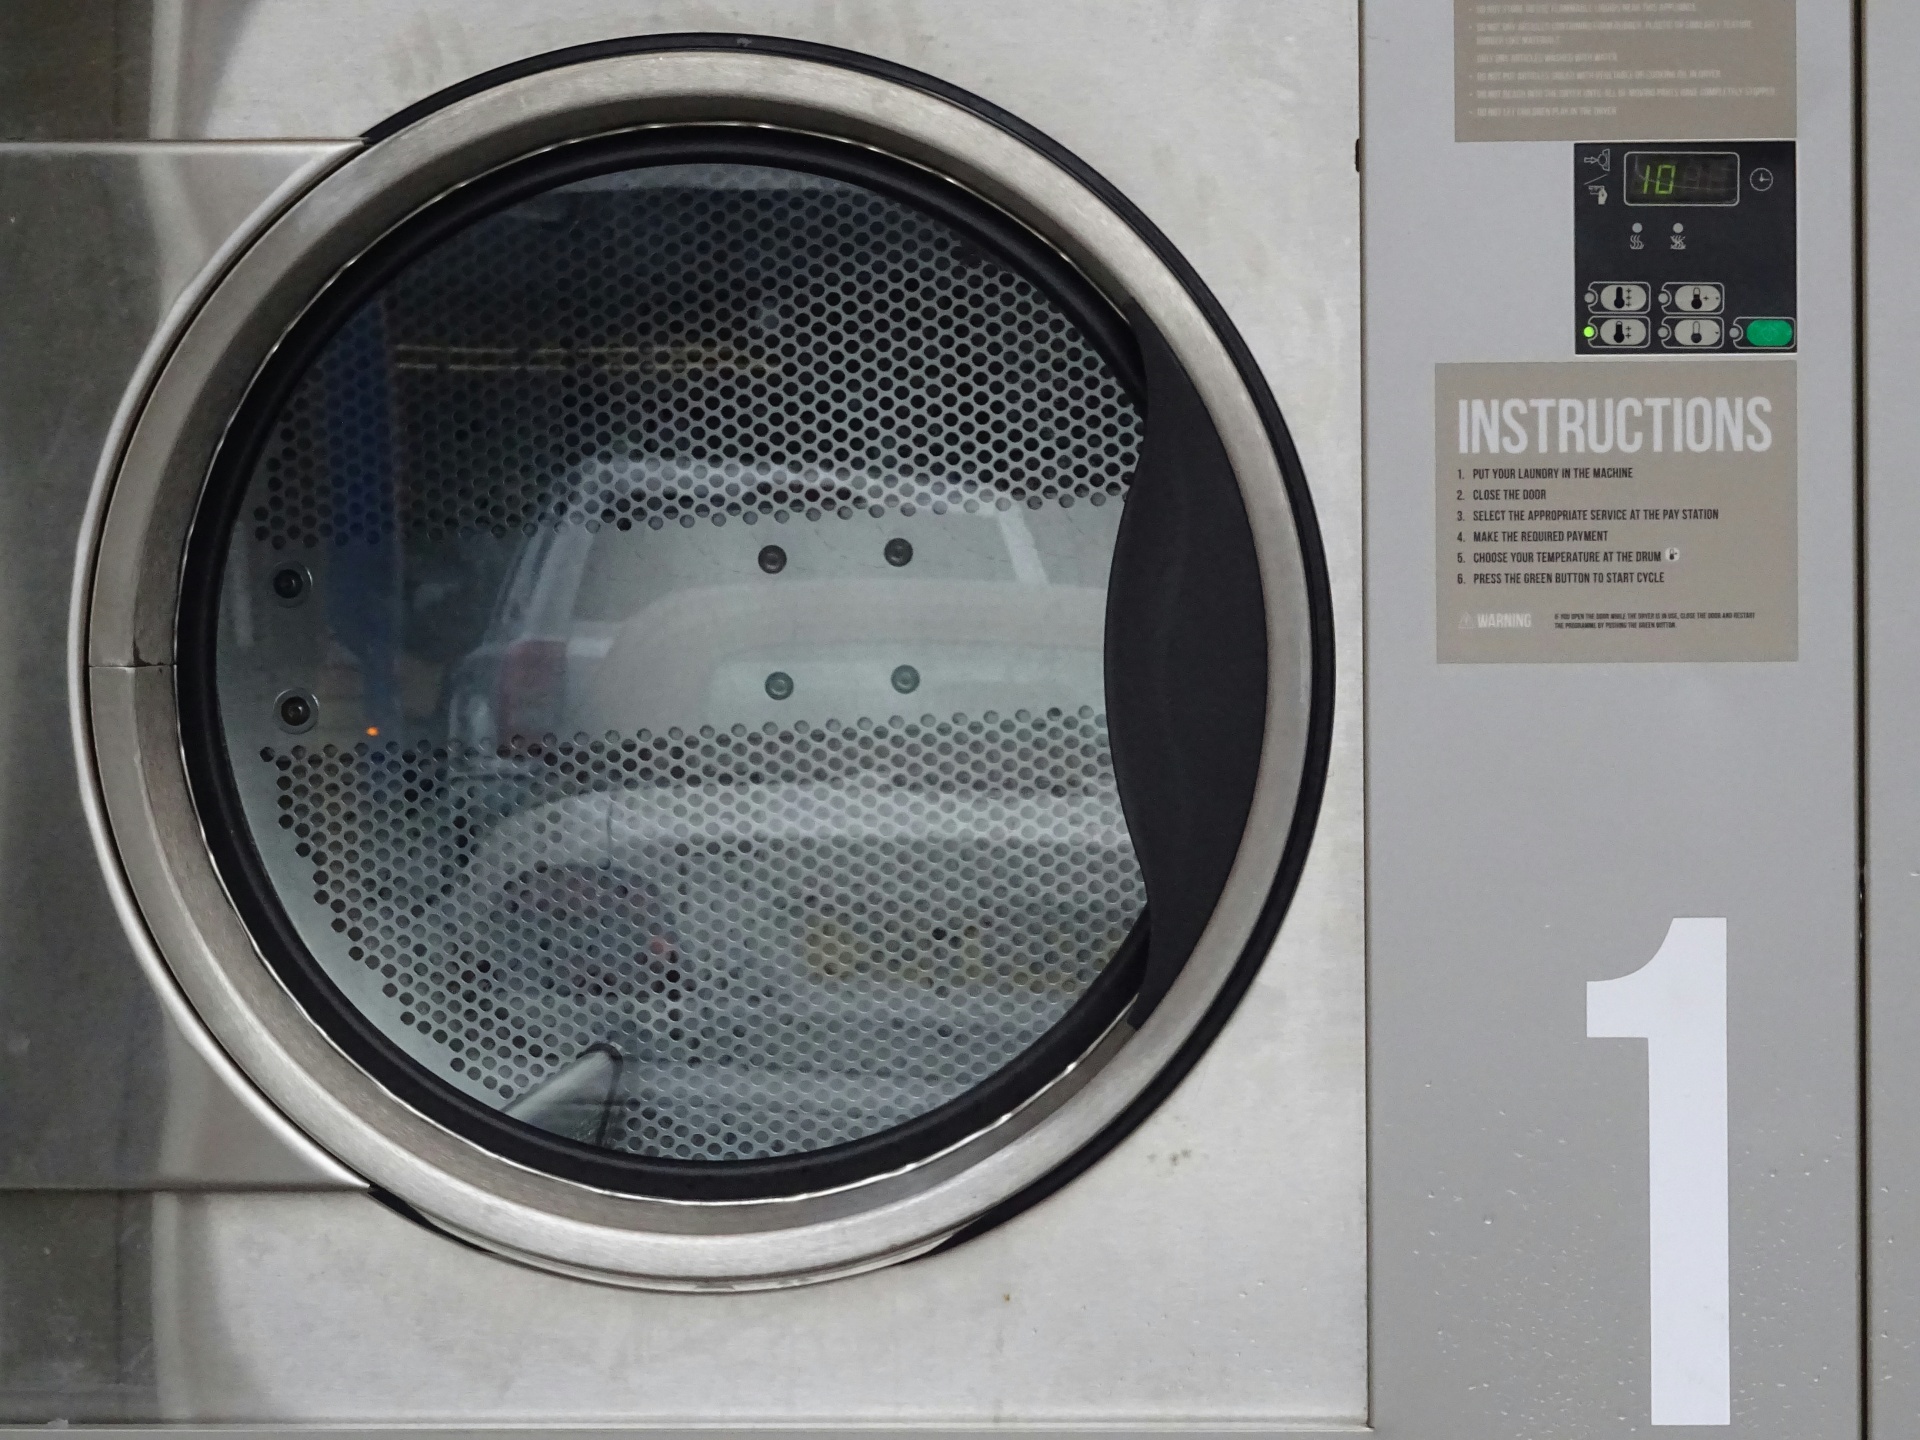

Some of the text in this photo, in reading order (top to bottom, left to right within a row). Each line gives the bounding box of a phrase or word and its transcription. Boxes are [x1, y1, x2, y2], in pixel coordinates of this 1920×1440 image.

[1643, 164, 1676, 195] 10
[1459, 397, 1771, 454] INSTRUCTIONS
[1457, 468, 1633, 480] 1. PUT YOUR LAUNDRY IN THE MACHINE
[1457, 489, 1546, 501] 2. CLOSE THE DOOR
[1457, 509, 1719, 522] 3. SELECT THE APPROPRIATE SERVICE AT THE PAY STATION
[1457, 531, 1607, 543] 4. MAKE THE REQUIRED PAYMENT
[1457, 551, 1661, 564] 5. CHOOSE YOUR TEMPERATURE AT THE DRUM
[1457, 572, 1664, 585] 6. PRESS THE GREEN BUTTON TO START CYCLE
[1477, 613, 1532, 628] WARNING
[1587, 917, 1730, 1426] 1
